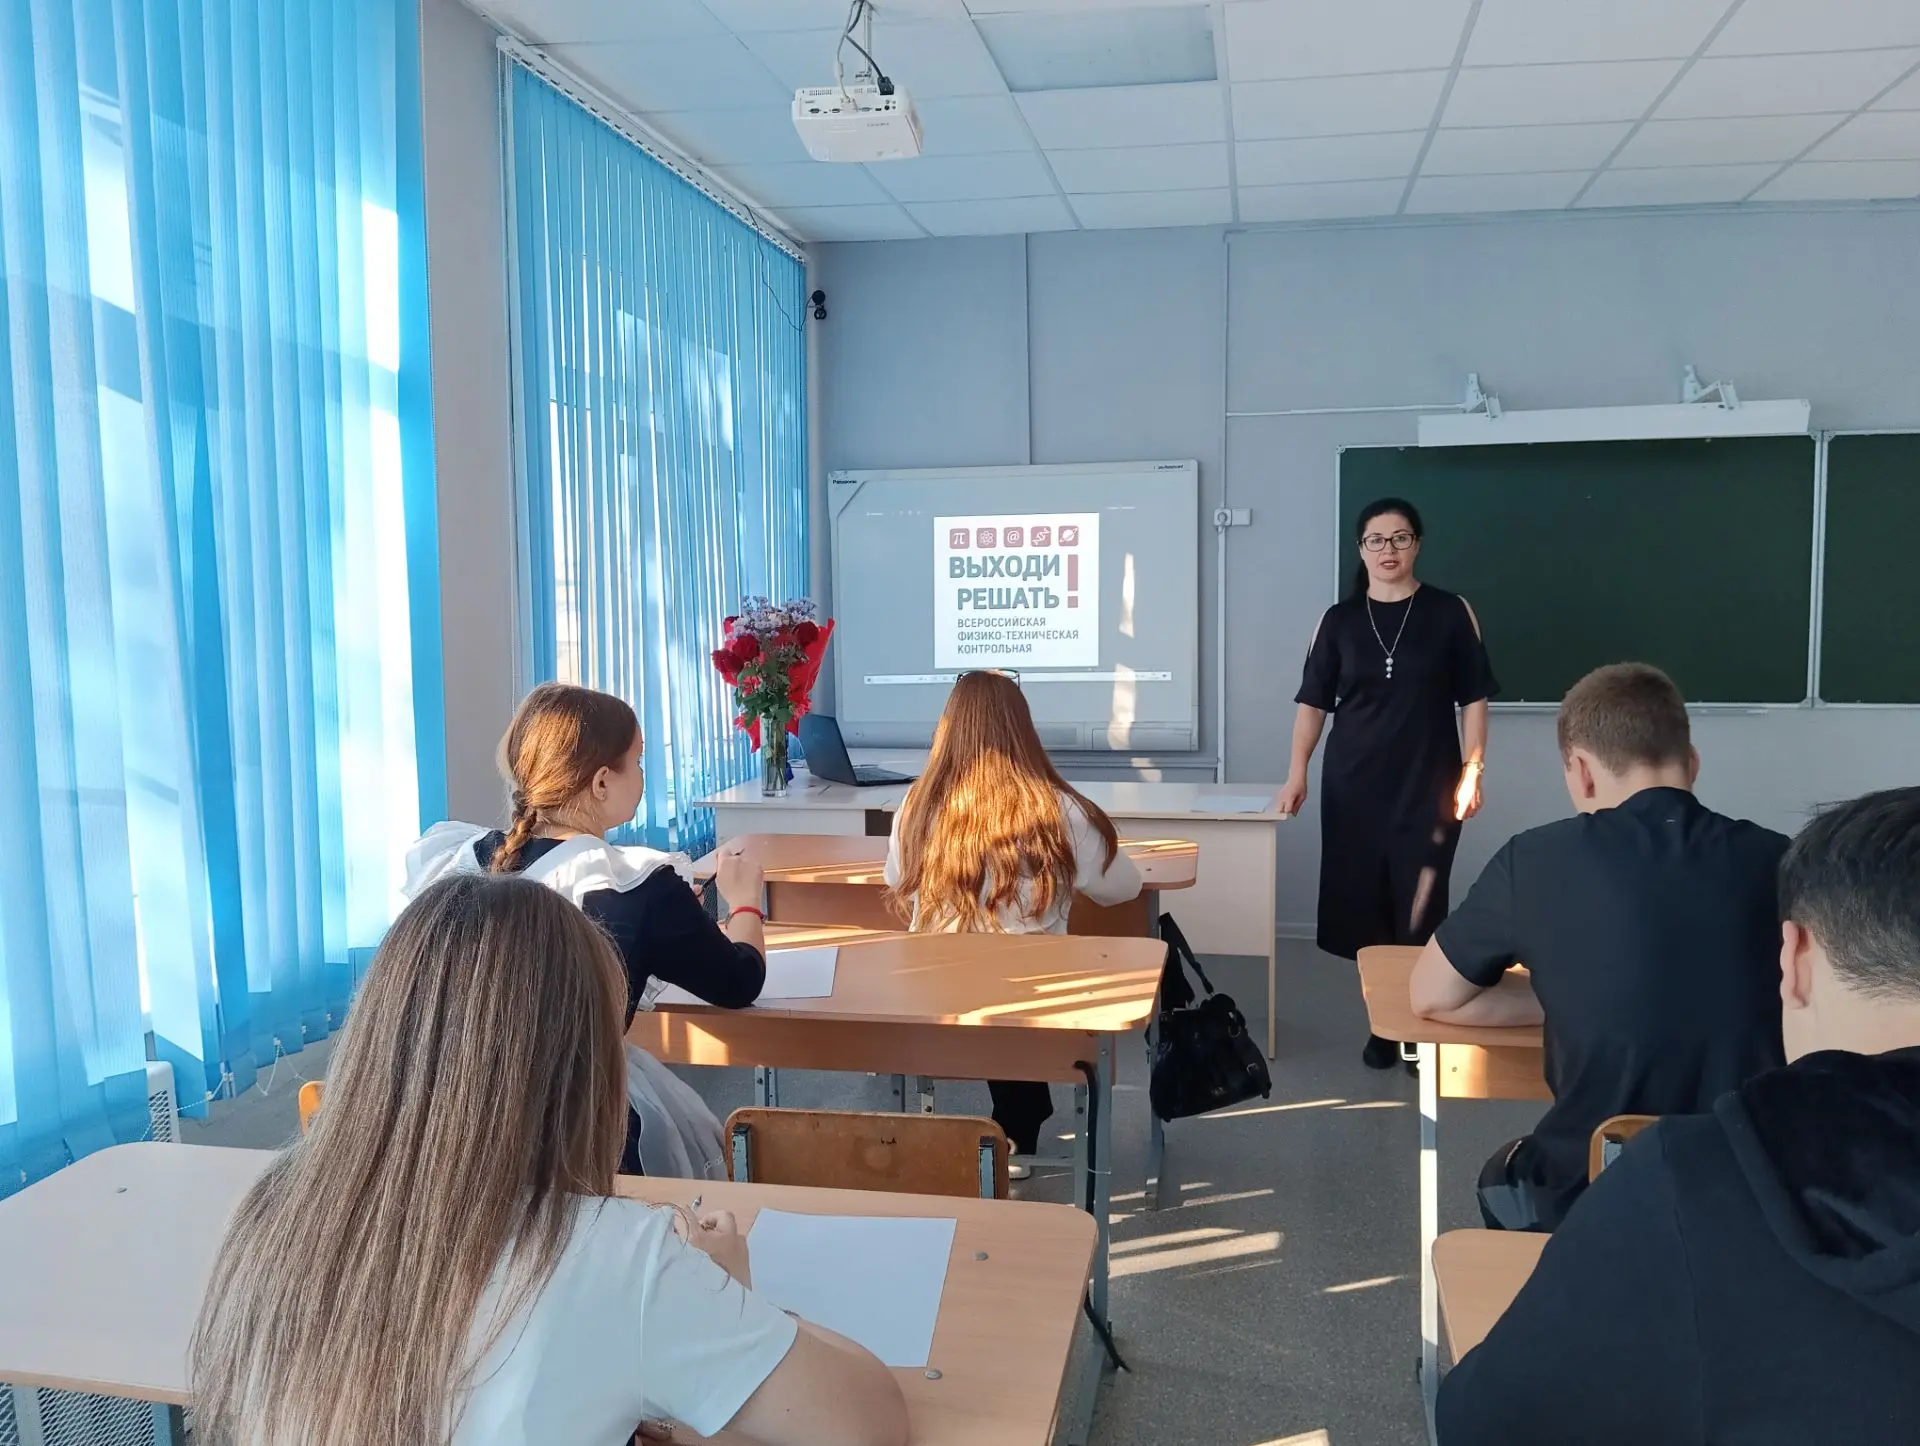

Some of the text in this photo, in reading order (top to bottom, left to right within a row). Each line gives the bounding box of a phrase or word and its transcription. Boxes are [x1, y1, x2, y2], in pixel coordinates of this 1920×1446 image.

[949, 554, 1060, 581] ВЫХОДИ
[957, 587, 1060, 611] РЕШАТЬ
[957, 616, 1046, 628] ВСЕРОССИЙСКАЯ
[957, 629, 1080, 641] ФИЗИКО-ТЕХНИЧЕСКАЯ
[957, 643, 1032, 654] КОНТРОЛЬНАЯ
